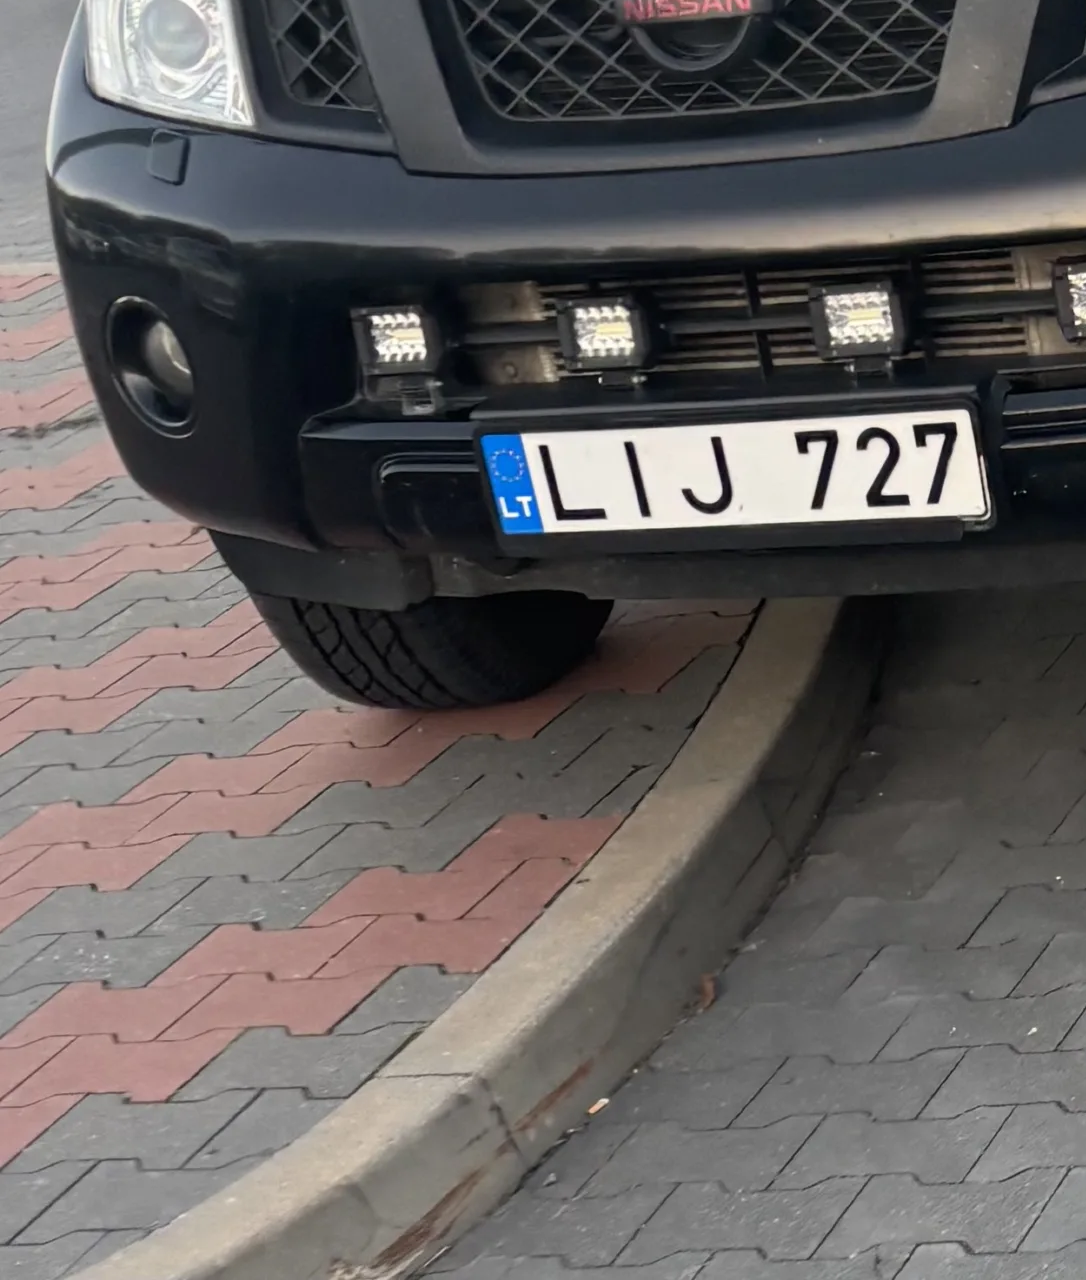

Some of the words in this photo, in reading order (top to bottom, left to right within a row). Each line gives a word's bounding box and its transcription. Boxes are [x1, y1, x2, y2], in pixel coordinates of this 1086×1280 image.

[538, 435, 734, 521] LIJ
[794, 421, 958, 510] 727
[499, 496, 532, 518] LT
